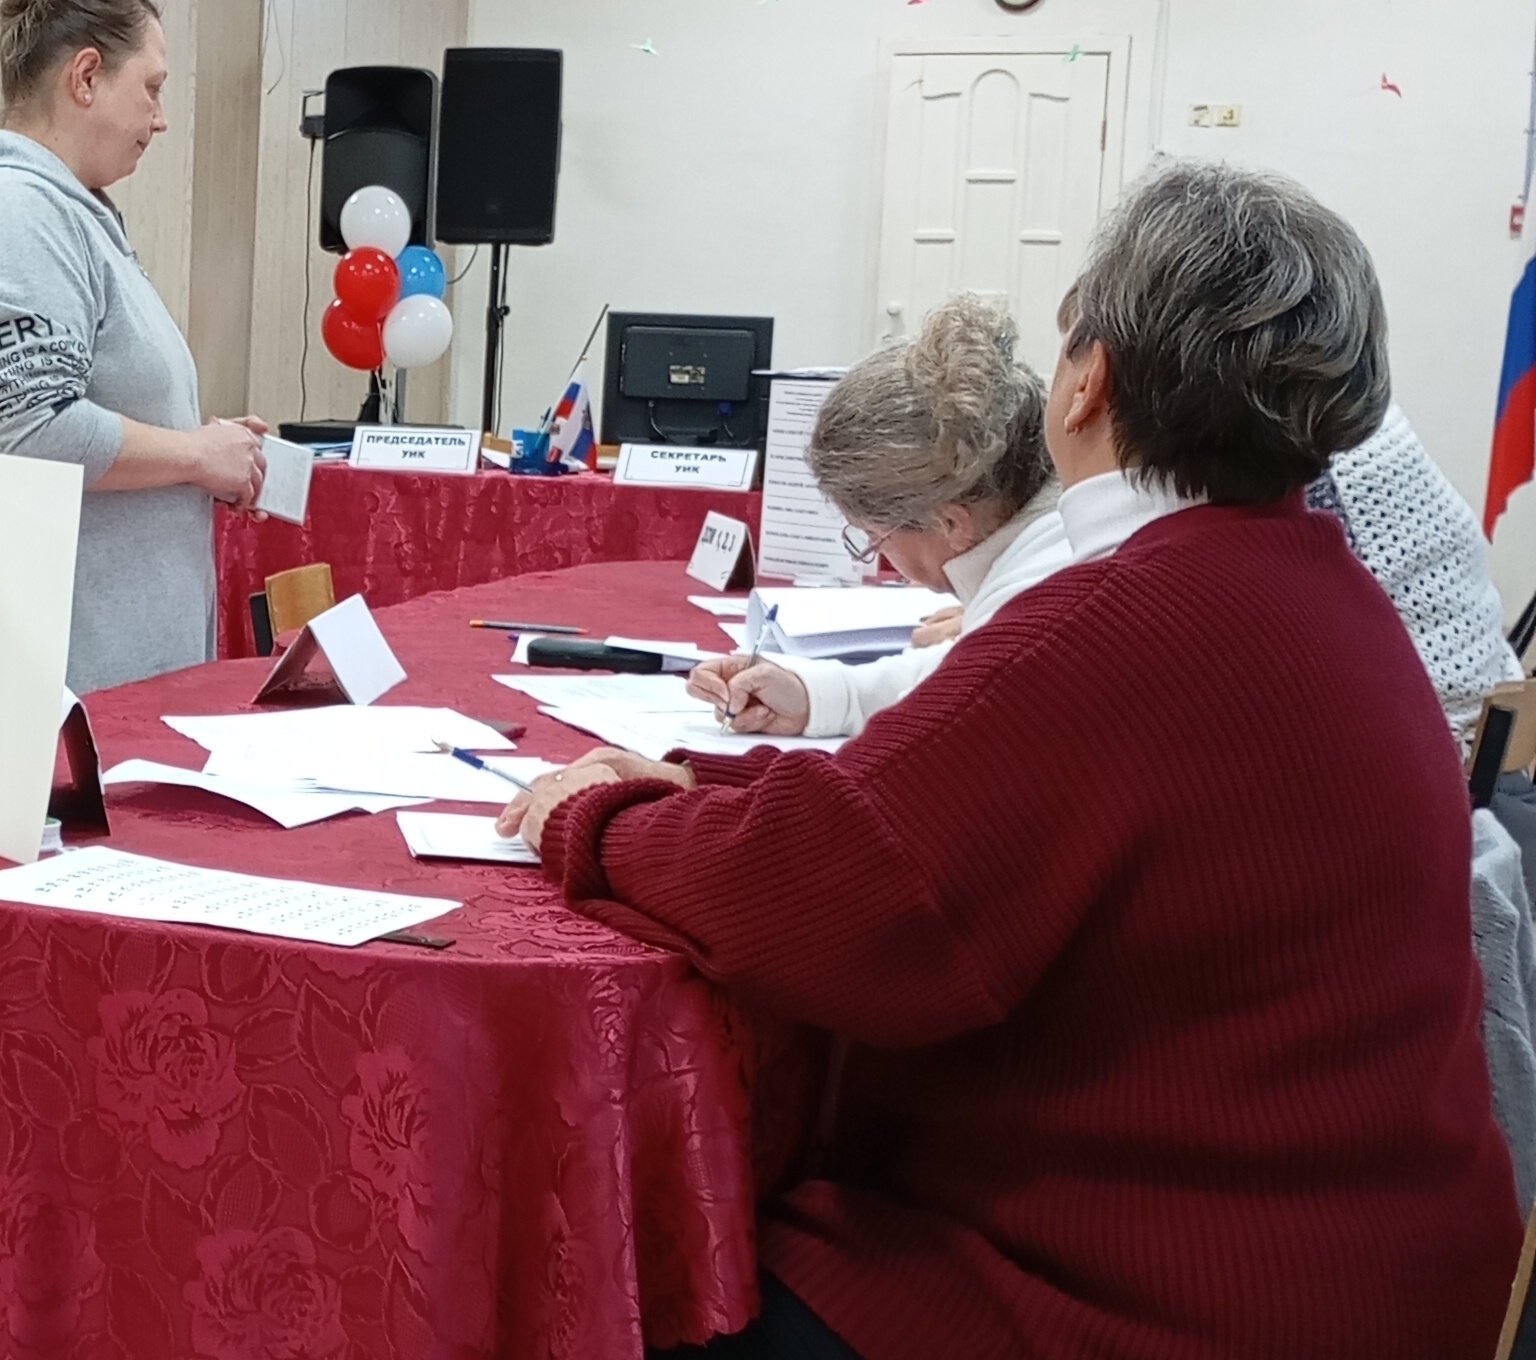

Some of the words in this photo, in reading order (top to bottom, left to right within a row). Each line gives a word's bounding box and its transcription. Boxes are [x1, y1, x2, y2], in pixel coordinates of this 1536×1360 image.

[21, 346, 36, 360] IS
[38, 344, 48, 354] A
[366, 435, 466, 446] ПРЕДСЕДАТЕЛЬ
[401, 450, 426, 459] УИК
[650, 450, 727, 462] СЕКРЕТАРЬ
[675, 465, 700, 474] УИК
